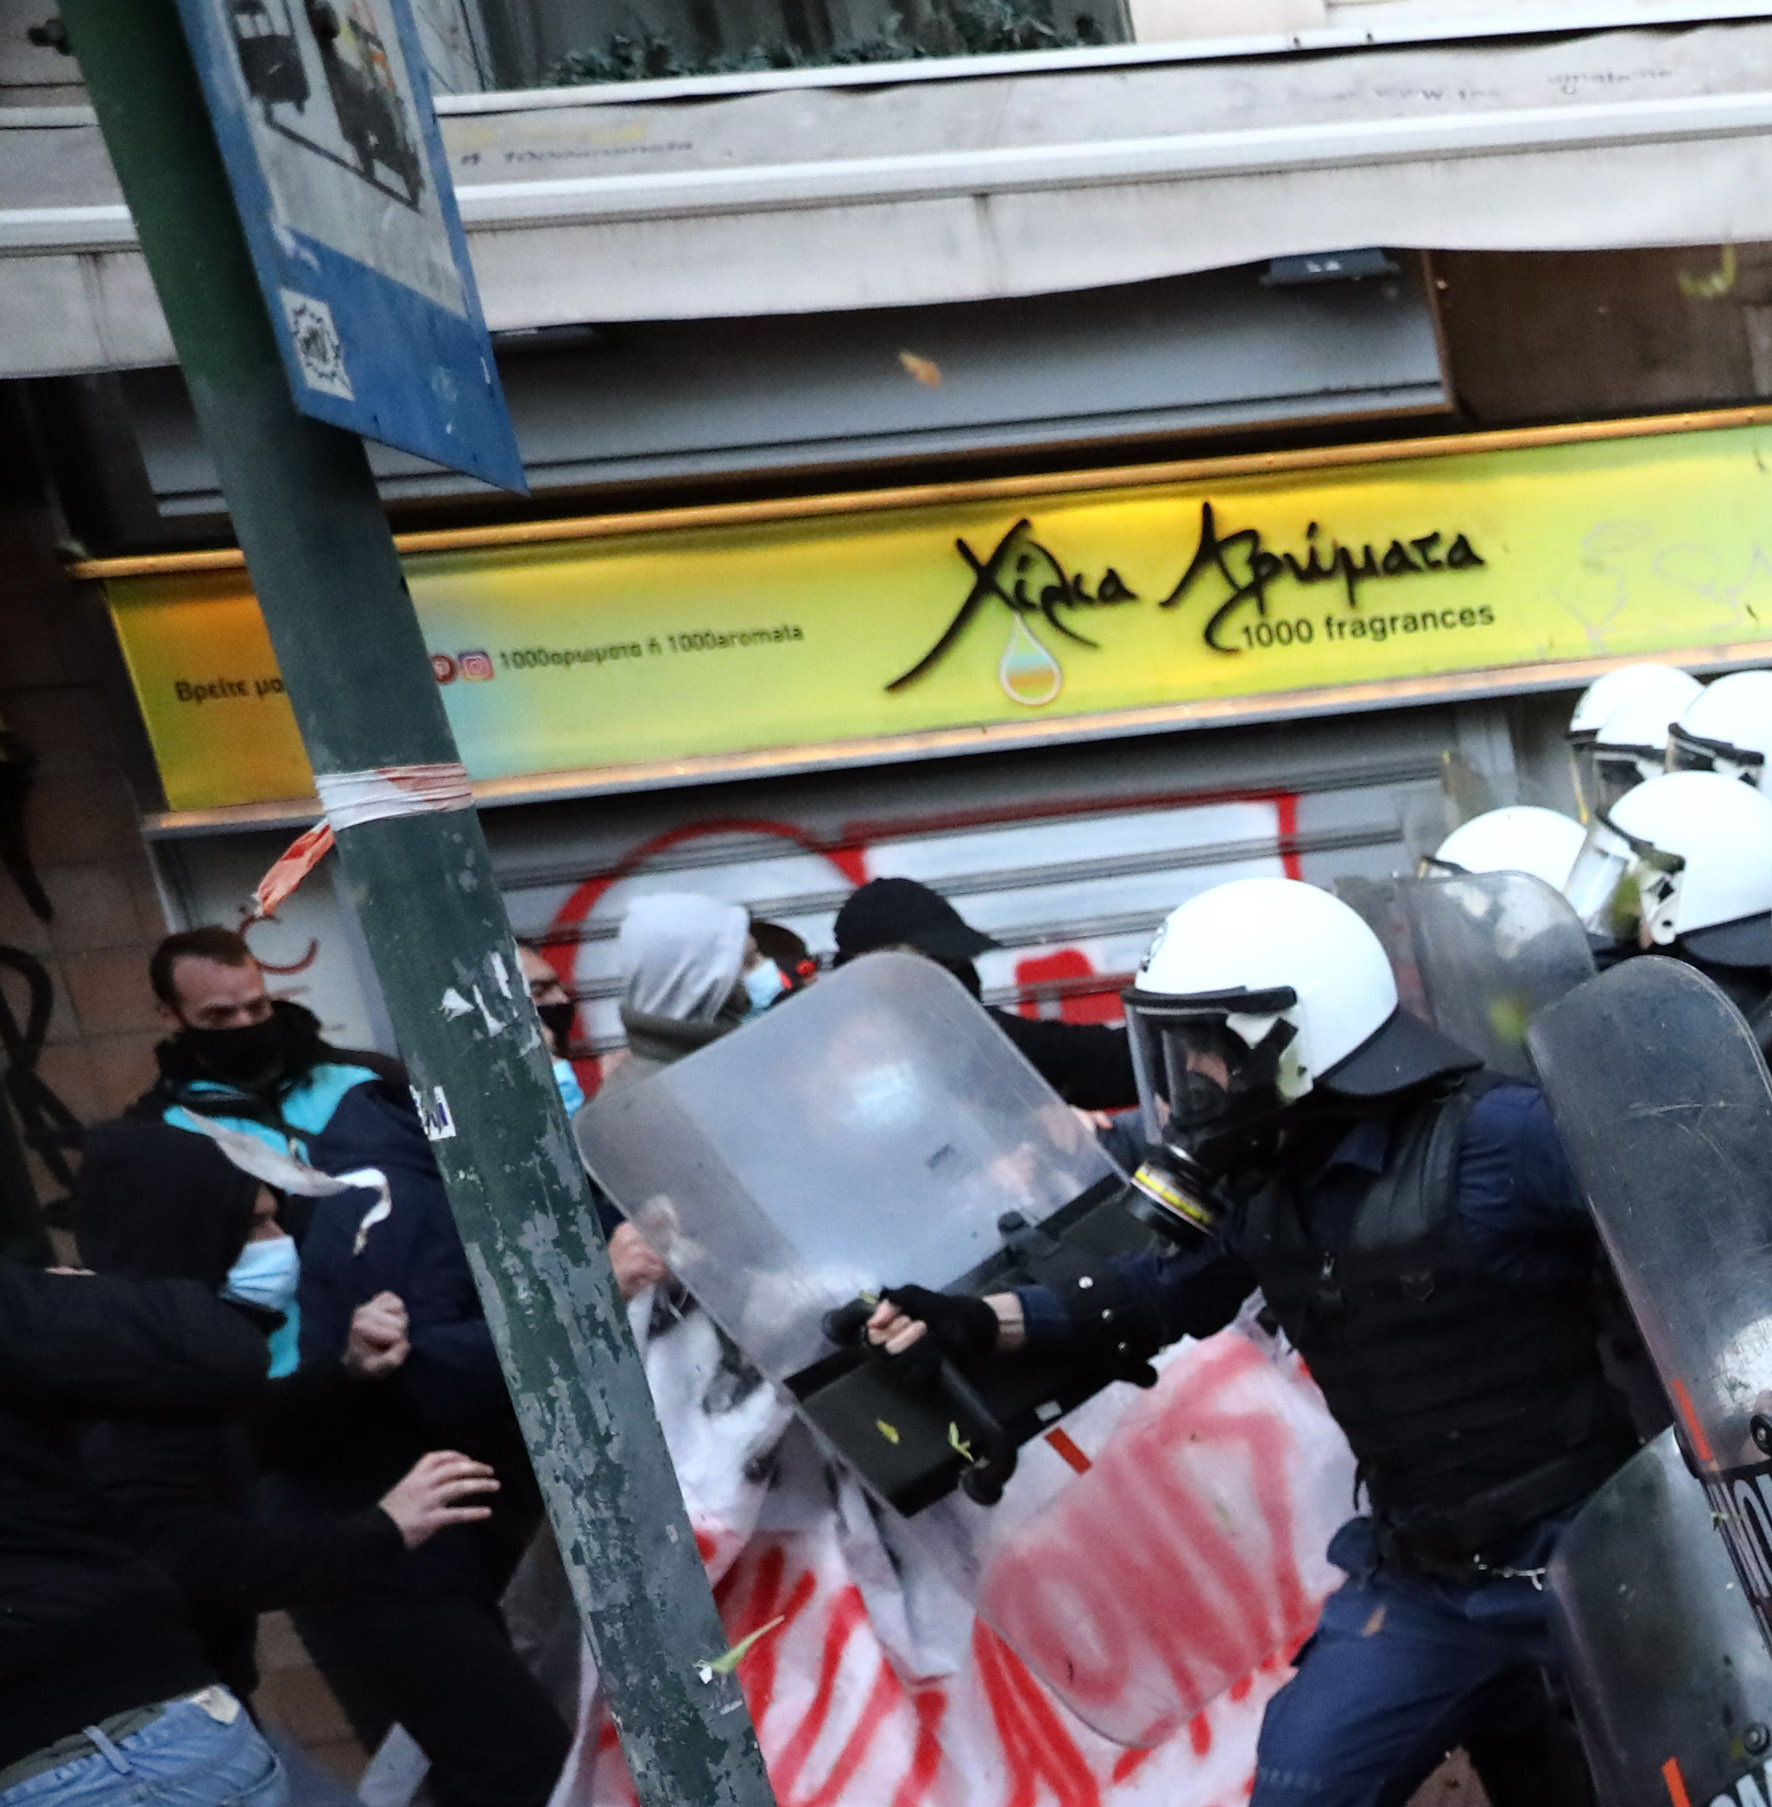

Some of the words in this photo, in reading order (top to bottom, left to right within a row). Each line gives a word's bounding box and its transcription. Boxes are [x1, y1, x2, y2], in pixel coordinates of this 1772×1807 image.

[668, 622, 806, 655] 1000aromata
[1241, 616, 1313, 650] 1000
[1324, 602, 1496, 646] fragrances
[253, 677, 287, 704] μα
